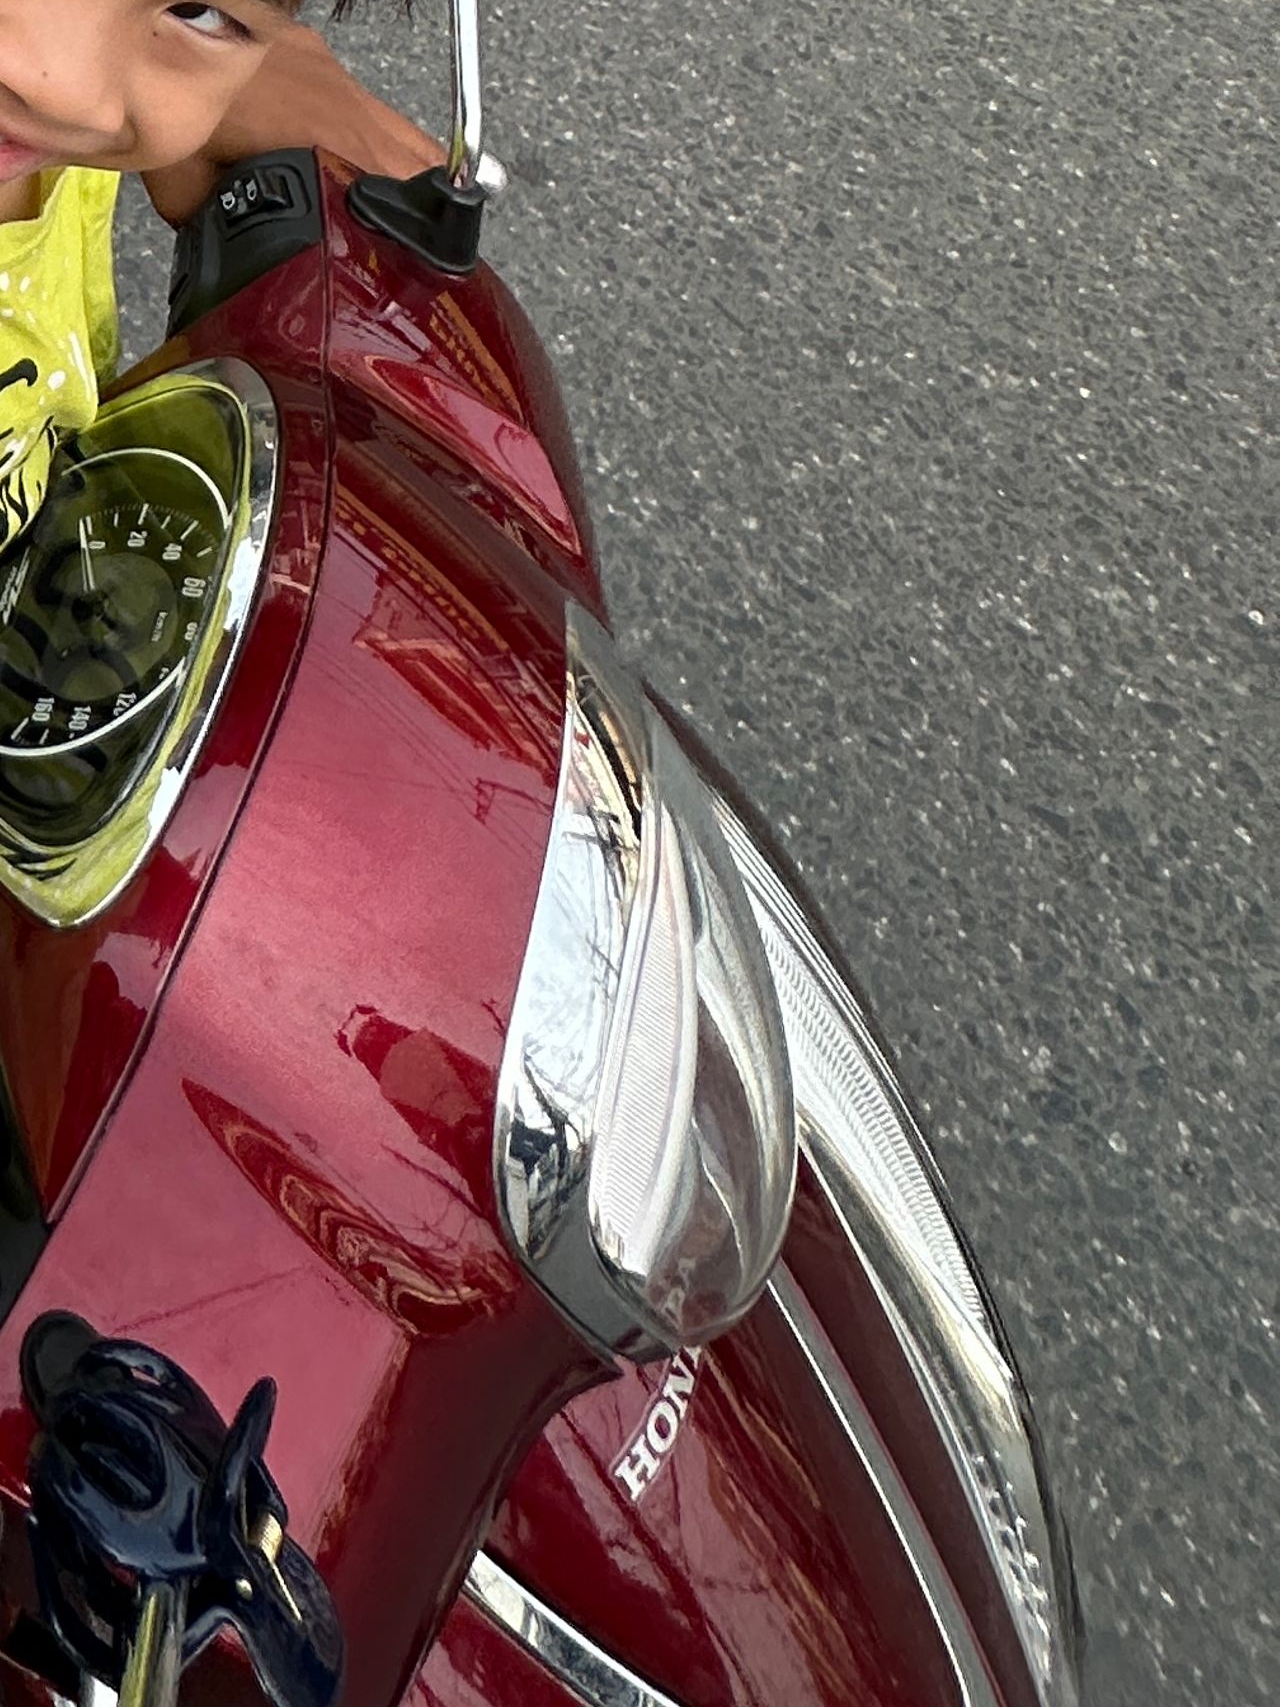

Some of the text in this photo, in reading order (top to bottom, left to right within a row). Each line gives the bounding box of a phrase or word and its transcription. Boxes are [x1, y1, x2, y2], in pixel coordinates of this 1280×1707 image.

[89, 540, 106, 550] 0
[127, 530, 147, 548] 20
[162, 542, 183, 561] 40
[181, 576, 206, 598] 60
[31, 696, 55, 723] 160
[68, 705, 91, 731] 140
[613, 1344, 703, 1502] HON
